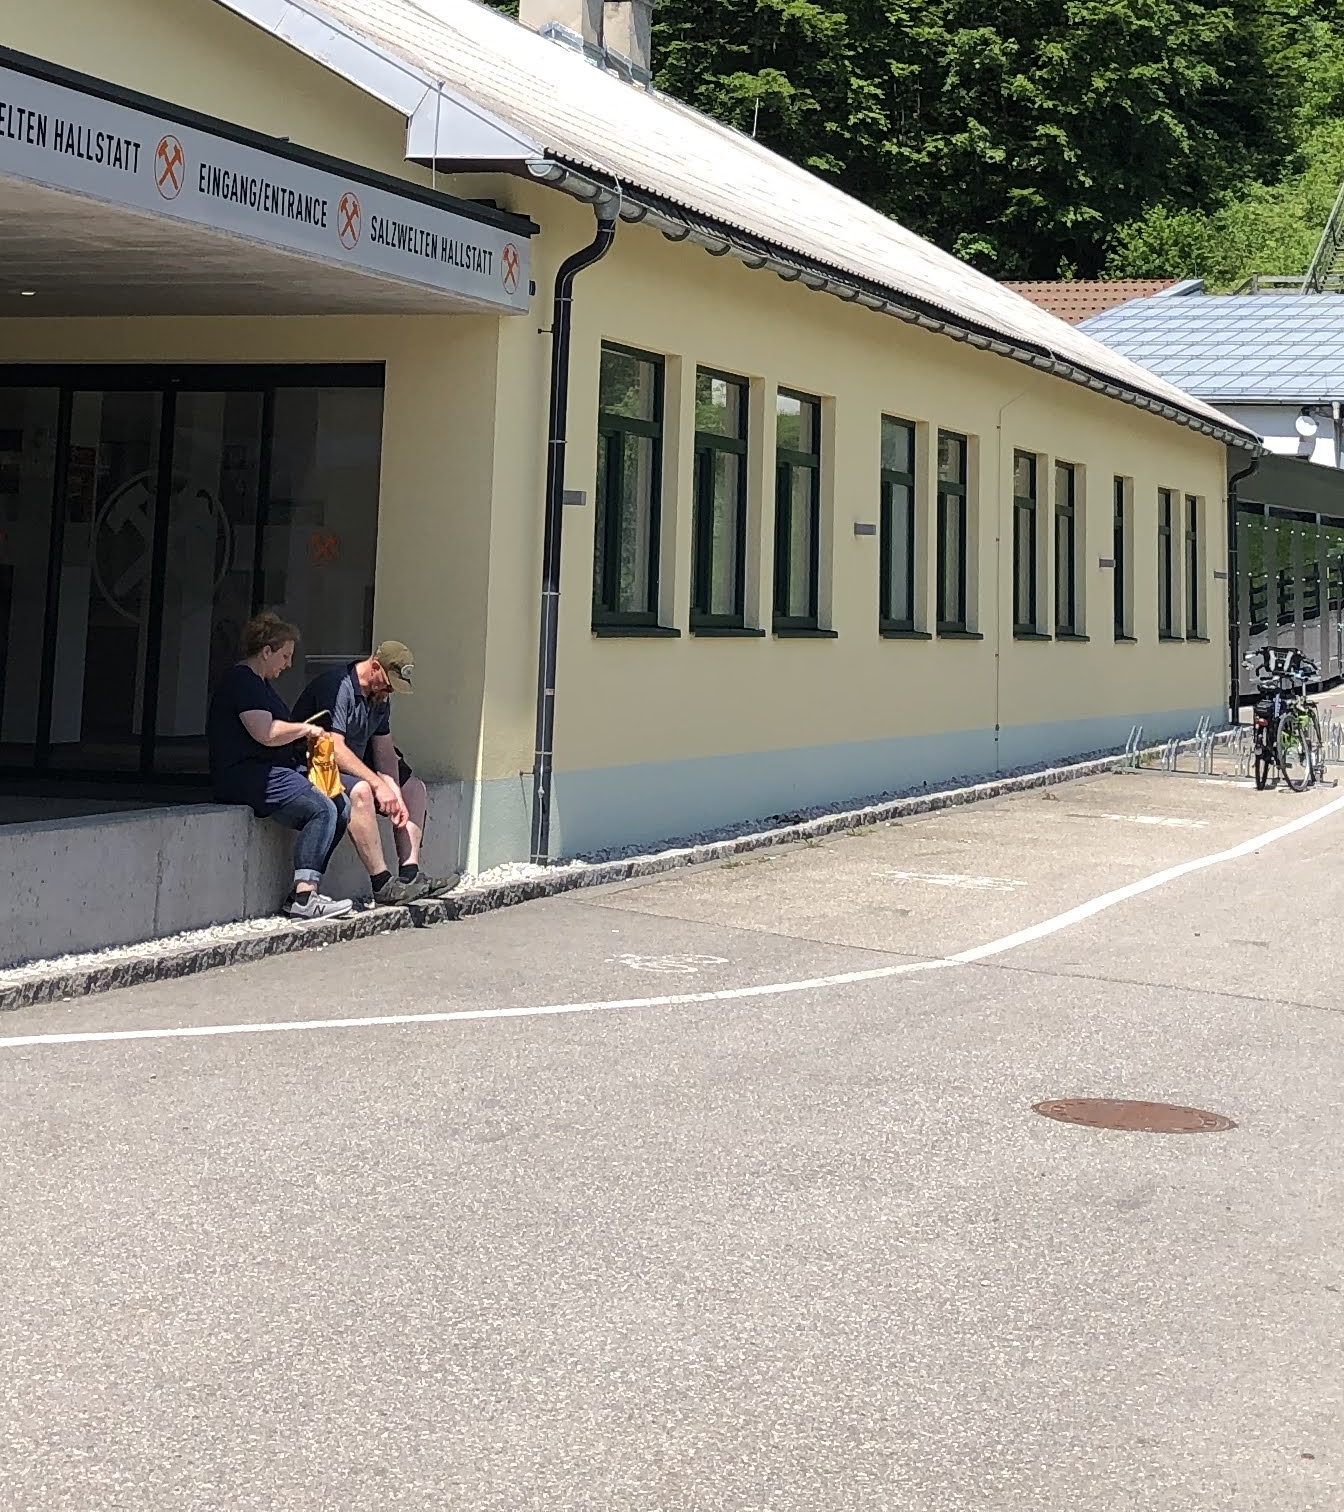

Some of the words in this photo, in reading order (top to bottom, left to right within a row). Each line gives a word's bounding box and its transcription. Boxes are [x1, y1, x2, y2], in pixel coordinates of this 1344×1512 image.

[53, 118, 142, 174] HALLSTATT
[198, 162, 328, 229] EINGANG/ENTRANCE
[370, 215, 439, 260] SALZWELTEN
[440, 236, 493, 276] HALLSTATT
